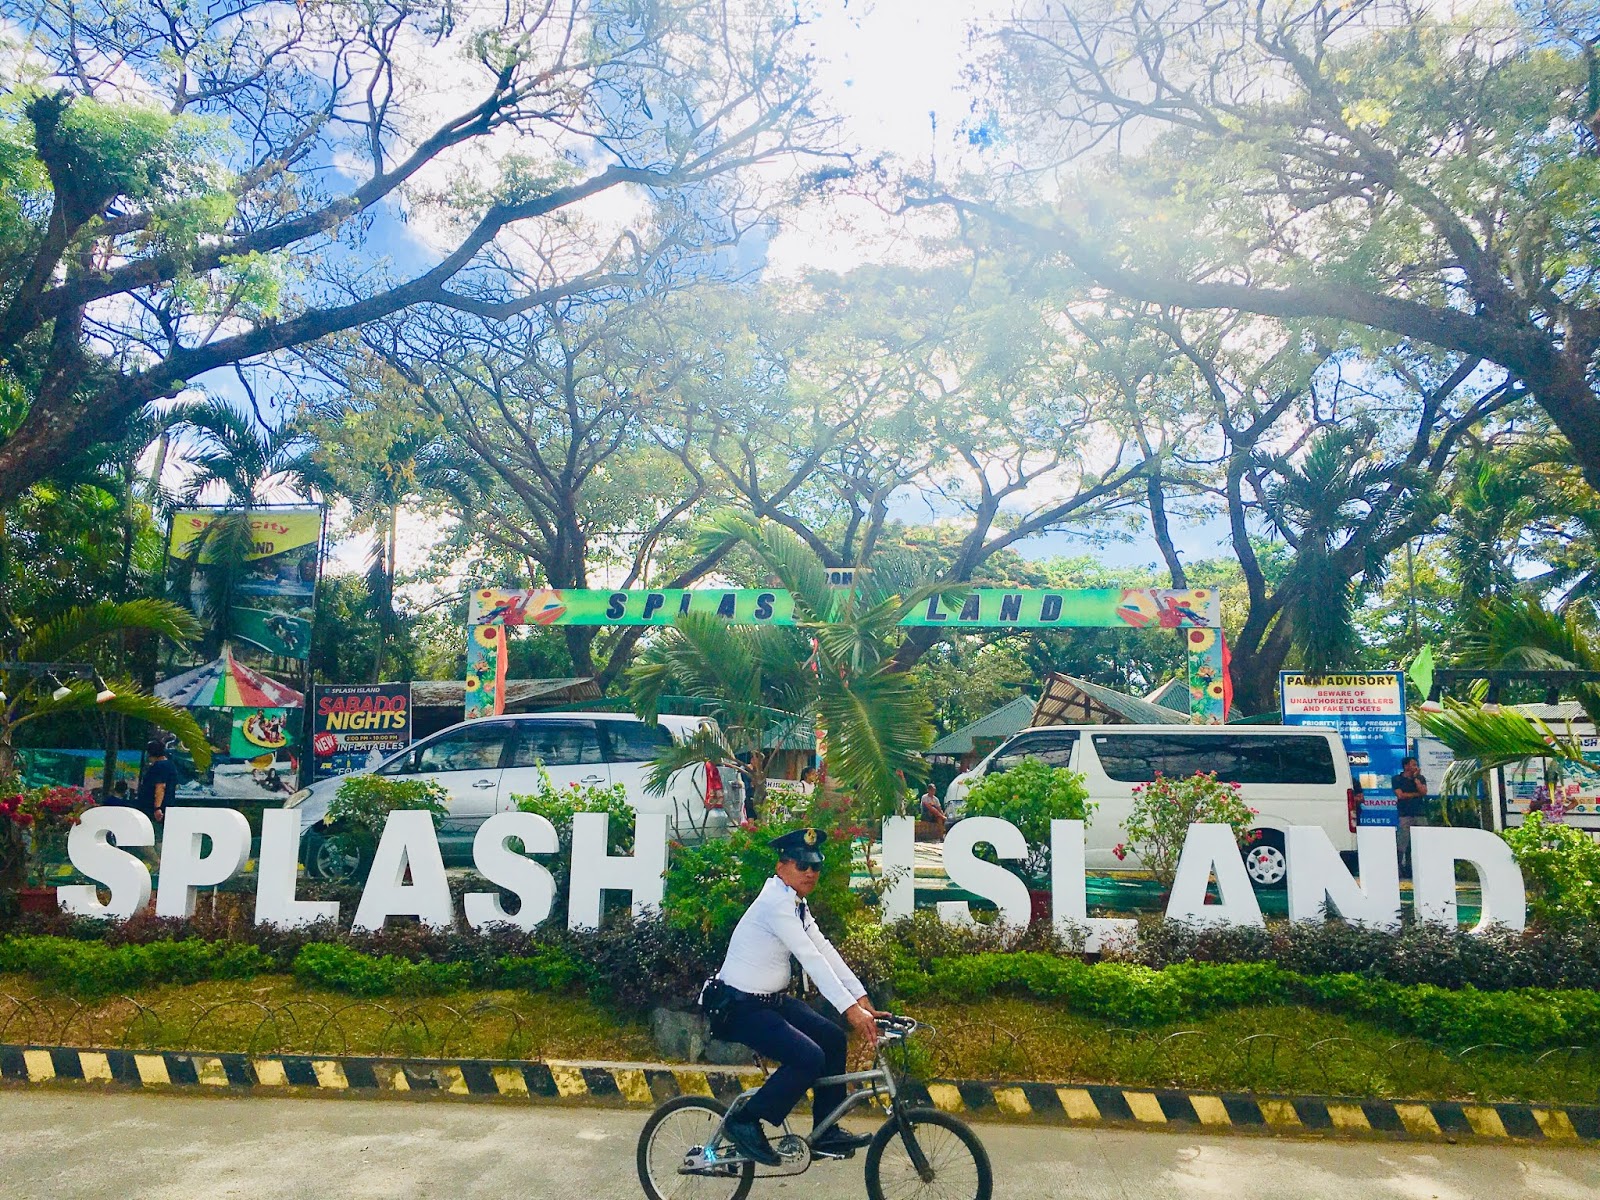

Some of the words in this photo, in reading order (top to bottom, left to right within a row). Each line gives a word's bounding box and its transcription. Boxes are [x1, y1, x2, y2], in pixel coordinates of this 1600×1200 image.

[606, 592, 803, 620] SPLAS
[925, 593, 1064, 621] LAND
[1326, 676, 1394, 686] ADVISORY
[318, 695, 406, 716] SABADO
[326, 710, 407, 731] NIGHTS
[315, 736, 334, 752] NEW
[337, 742, 404, 752] INFLATABLES
[57, 806, 669, 935] SPLASH
[881, 814, 1526, 953] ISLAND
